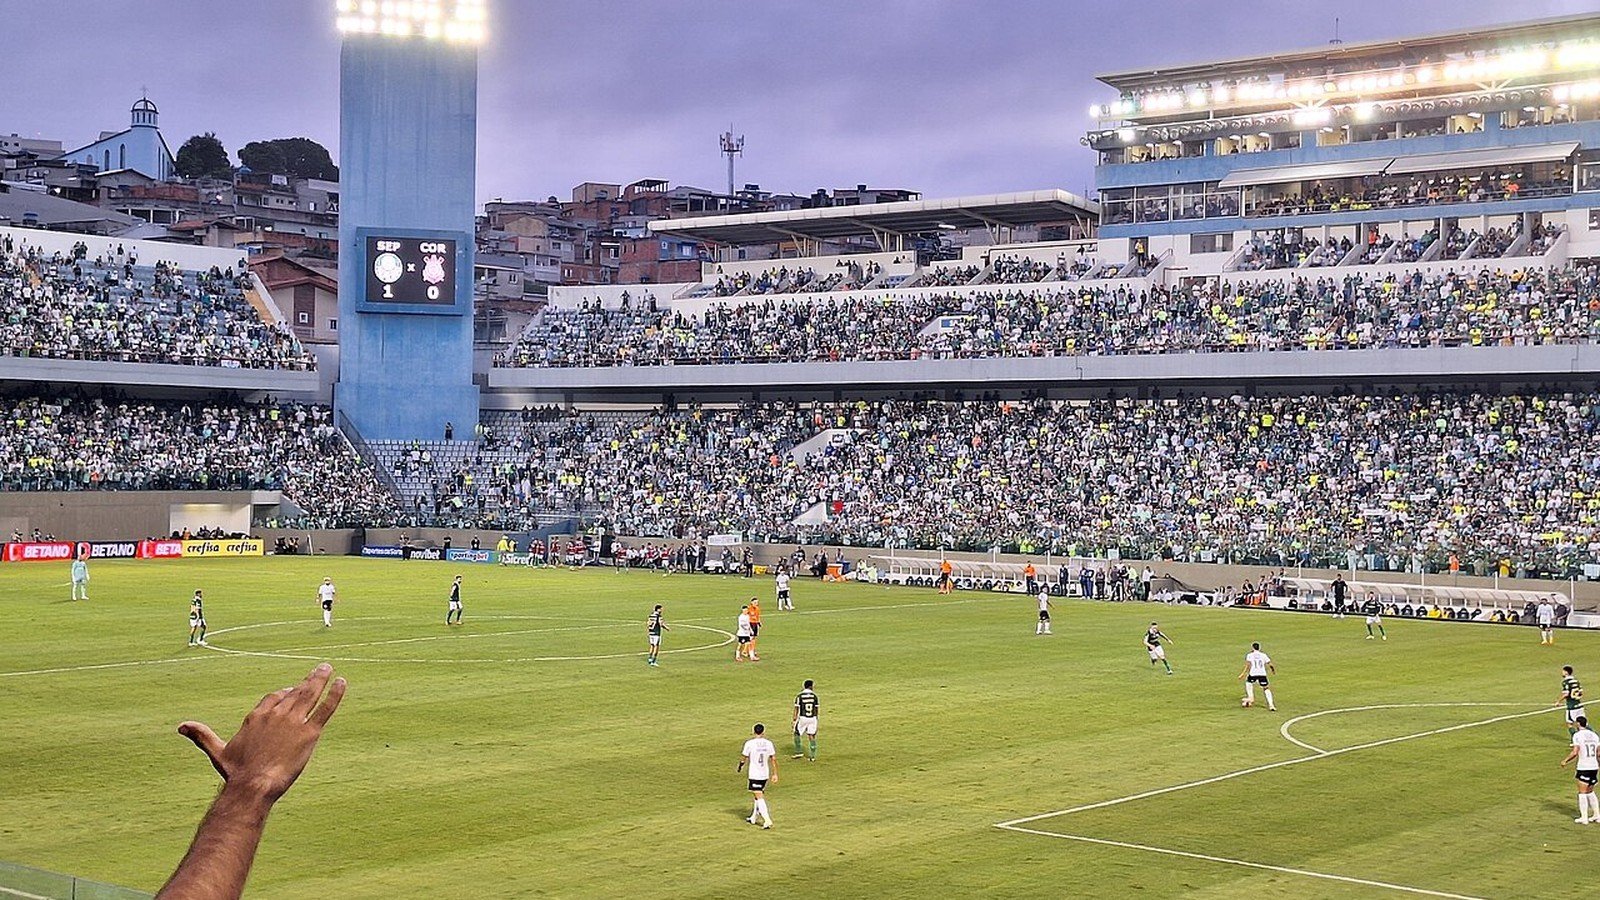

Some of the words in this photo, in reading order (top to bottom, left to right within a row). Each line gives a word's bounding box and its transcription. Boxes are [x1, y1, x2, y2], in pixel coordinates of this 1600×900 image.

[377, 241, 401, 252] SEP
[420, 242, 447, 254] COR
[383, 284, 395, 298] 1
[427, 285, 440, 300] 0
[23, 545, 70, 558] BETANO
[91, 543, 135, 557] BETANO
[187, 541, 220, 555] crefisa
[226, 541, 258, 554] crefisa
[410, 549, 440, 560] novibet
[450, 551, 489, 562] sportingbet
[805, 704, 813, 716] 9
[1585, 744, 1596, 757] 13
[758, 753, 764, 767] 4
